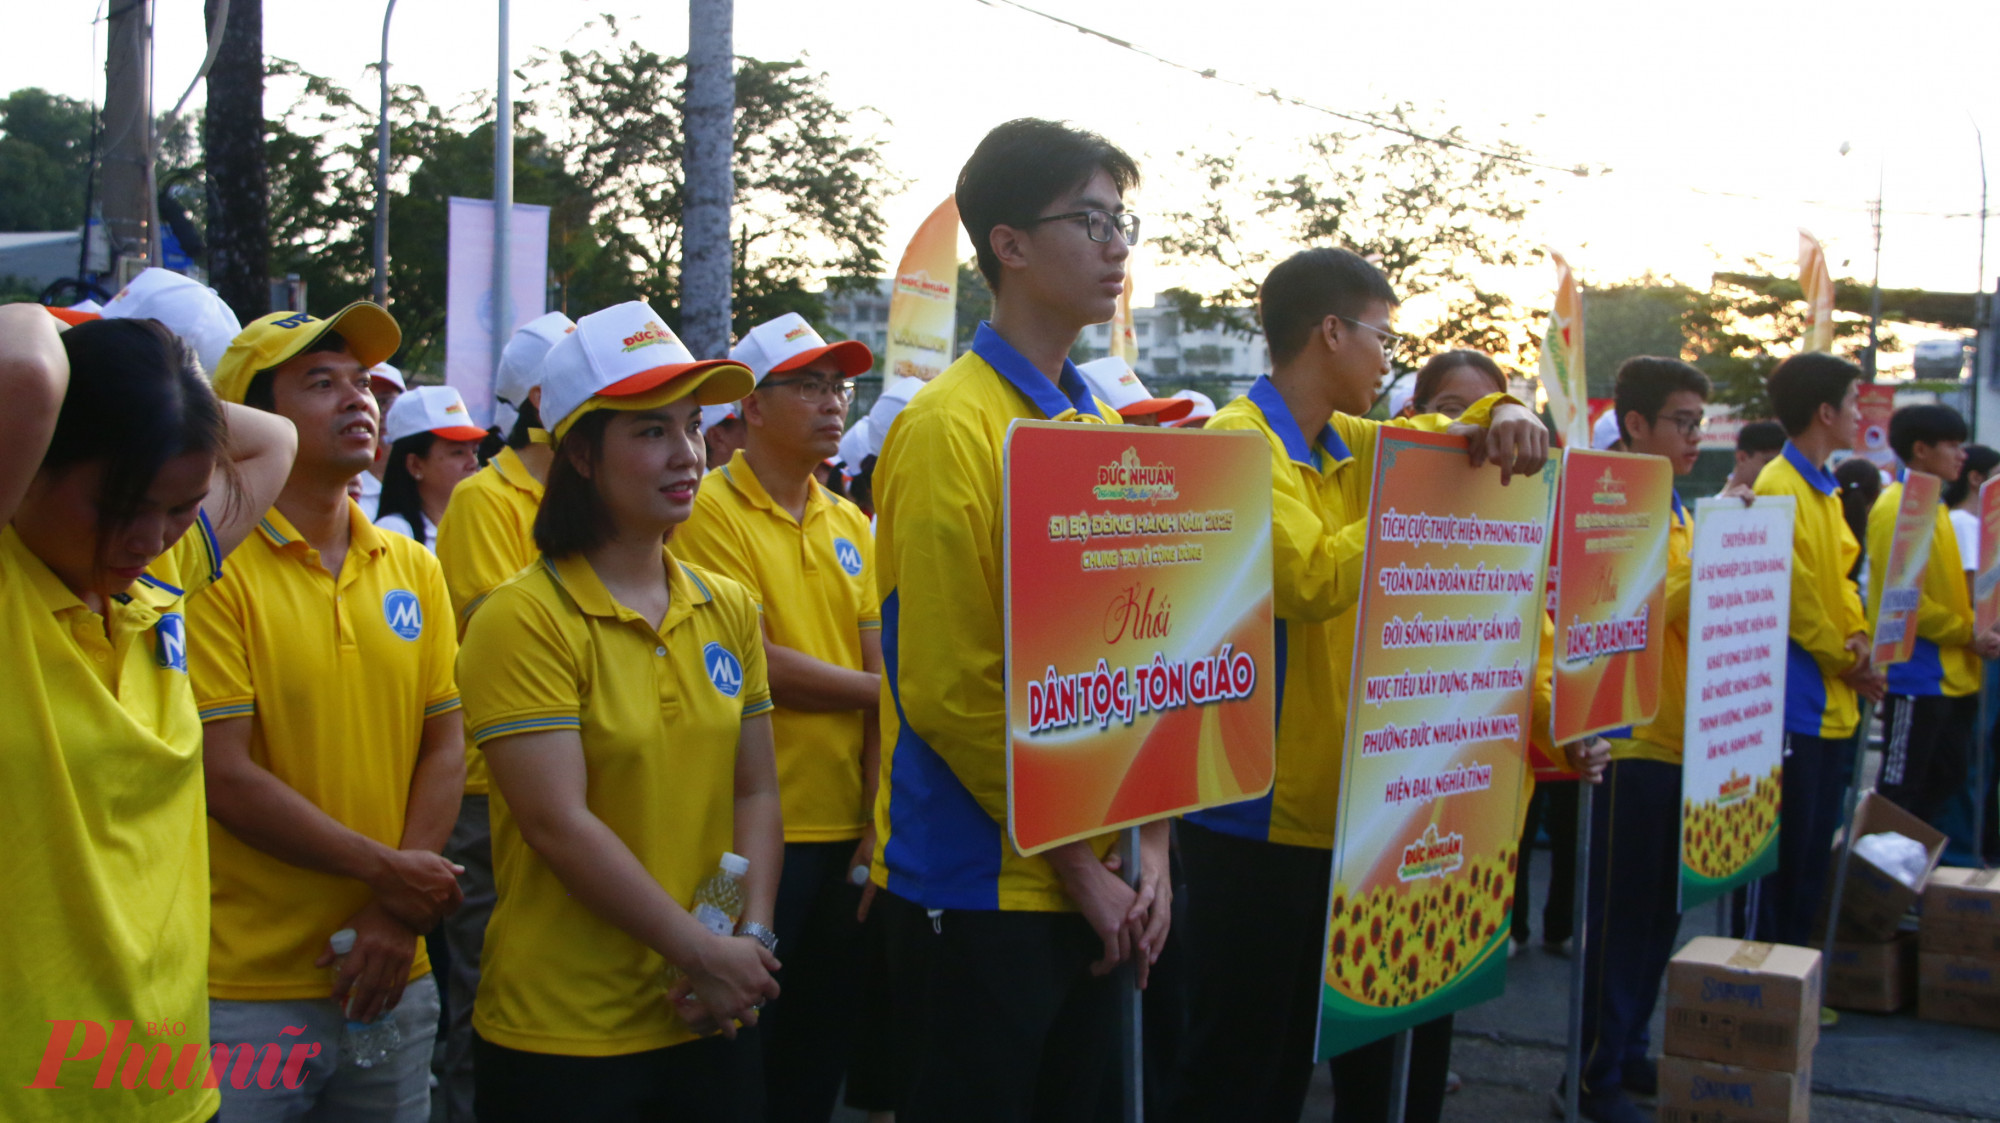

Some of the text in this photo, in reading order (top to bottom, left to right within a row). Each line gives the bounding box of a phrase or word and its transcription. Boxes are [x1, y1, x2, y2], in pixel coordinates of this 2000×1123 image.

[623, 330, 655, 347] ĐỨC
[1100, 463, 1174, 489] ĐỨC NHUẬN
[1050, 516, 1066, 539] ĐI
[1069, 511, 1089, 543] BỘ
[1091, 511, 1133, 536] ĐỒNG
[1135, 512, 1174, 534] HÀNH
[1381, 508, 1405, 540] TÍCH
[1408, 513, 1429, 547] CỰC
[1431, 515, 1457, 549] THỰC
[1459, 514, 1481, 549] HIỆN
[1483, 523, 1517, 544] PHONG
[1519, 519, 1543, 545] TRÀO
[1082, 551, 1118, 569] CHUNG
[1120, 550, 1140, 566] TAY
[1415, 564, 1436, 592] DÂN
[1438, 564, 1466, 592] ĐOÀN
[1468, 562, 1486, 592] KẾT
[1488, 566, 1505, 592] XÂY
[1507, 569, 1534, 596] DỰNG
[390, 600, 422, 627] M
[1103, 582, 1172, 644] Khối
[1383, 616, 1403, 646] ĐỜI
[1405, 613, 1433, 645] SỐNG
[1435, 617, 1454, 644] VĂN
[1484, 613, 1503, 641] GẮN
[1028, 643, 1255, 732] DÂN TỘC, TÔN GIÁO
[1367, 659, 1524, 706] MỤC TIÊU XÂY DỰNG, PHÁT TRIỂN
[1362, 714, 1520, 755] PHƯỜNG ĐỨC NHUẬN VĂN MINH,
[1385, 762, 1492, 806] HIỆN ĐẠI, NGHĨA TÌNH
